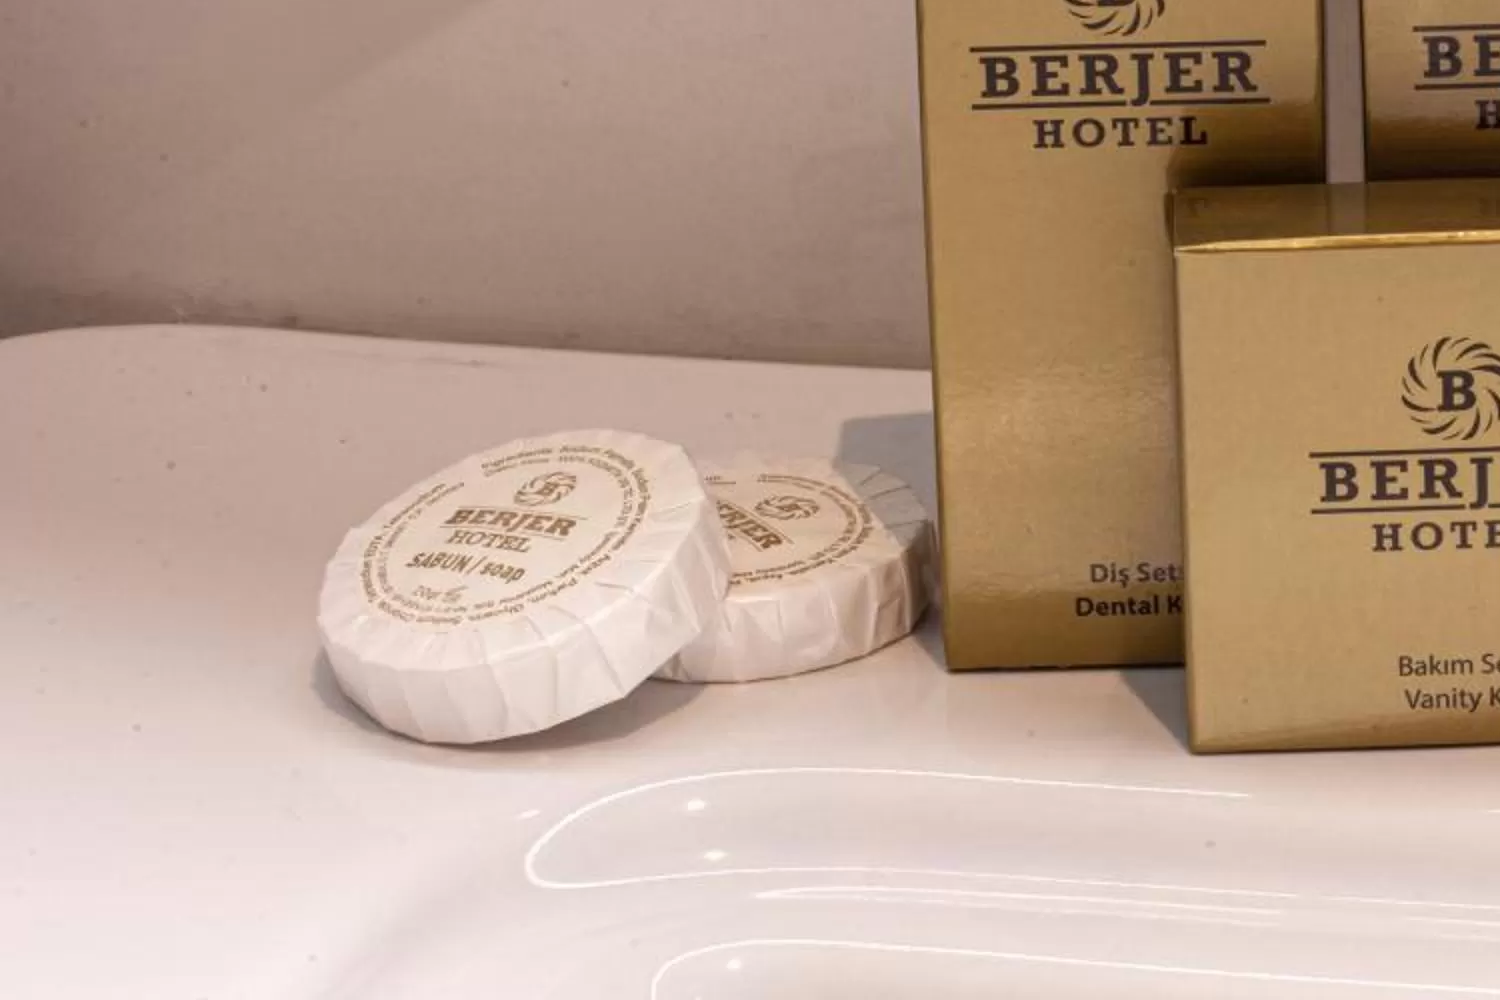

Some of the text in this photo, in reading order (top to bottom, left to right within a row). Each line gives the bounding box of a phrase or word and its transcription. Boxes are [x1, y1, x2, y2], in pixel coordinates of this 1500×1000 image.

[979, 50, 1258, 107] BERJER
[1032, 116, 1207, 149] HOTEL
[1438, 370, 1477, 412] B
[444, 508, 578, 537] BERJER
[445, 529, 532, 553] HOTEL
[1089, 562, 1130, 588] Diş
[1075, 594, 1160, 617] Dental
[1398, 653, 1474, 677] Bakım
[1403, 687, 1483, 713] Vanity
